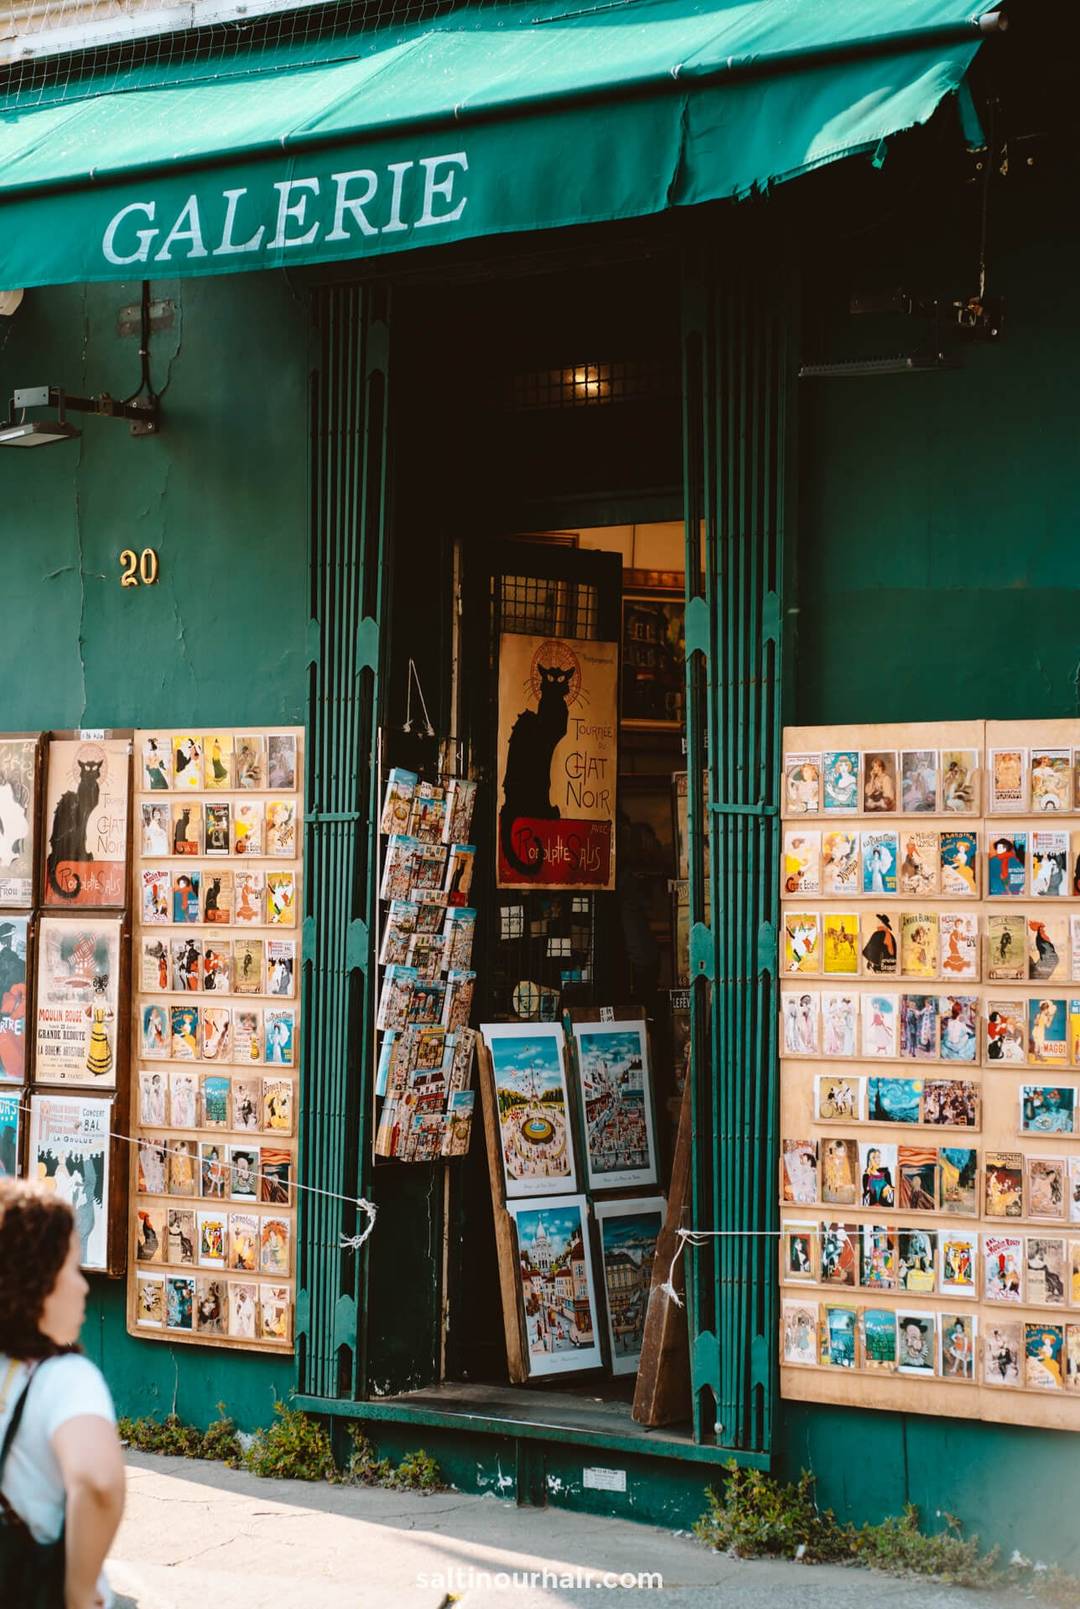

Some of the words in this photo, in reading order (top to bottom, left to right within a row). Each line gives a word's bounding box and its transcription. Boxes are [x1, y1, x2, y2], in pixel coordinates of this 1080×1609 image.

[102, 151, 469, 265] GALERIE
[119, 548, 160, 588] 20
[565, 751, 608, 786] CHAT
[566, 780, 611, 815] NOIR
[38, 1008, 63, 1022] MOULIN
[38, 1029, 61, 1040] GRANDE
[84, 1119, 101, 1132] BAL
